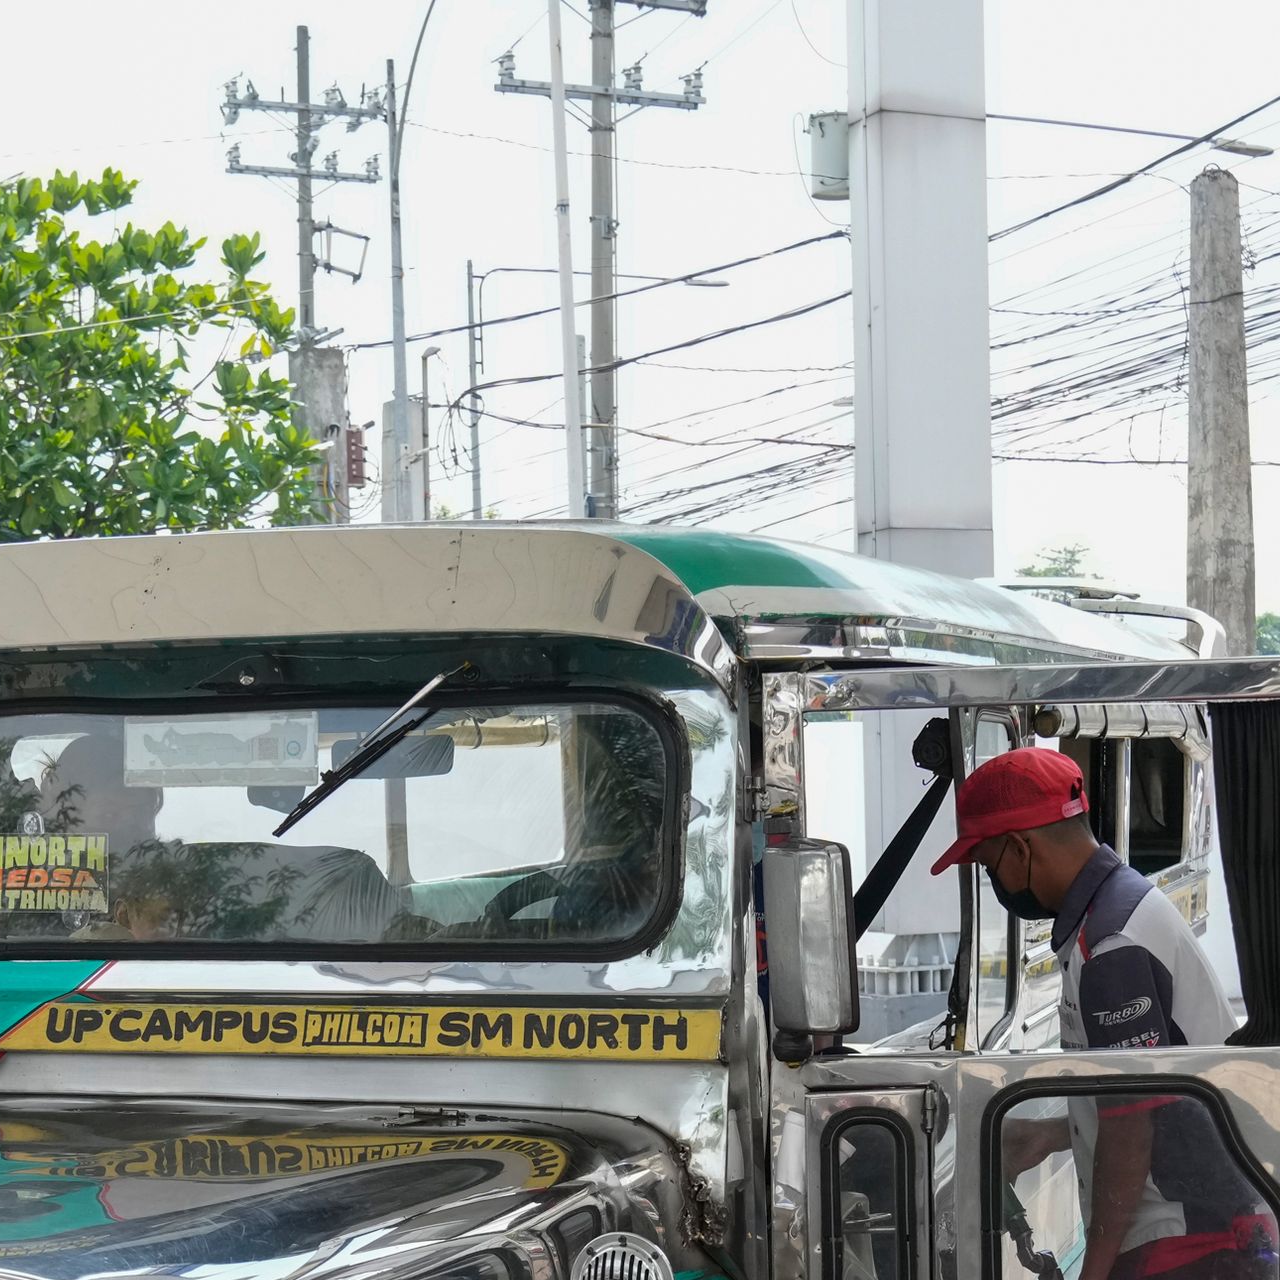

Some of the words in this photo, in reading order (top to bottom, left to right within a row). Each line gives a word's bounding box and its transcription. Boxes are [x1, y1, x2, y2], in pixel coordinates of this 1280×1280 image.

[5, 836, 106, 872] NORTH
[6, 868, 99, 888] EDSA
[5, 889, 109, 913] TRINOMA
[1092, 1003, 1140, 1025] TURBO
[109, 1009, 298, 1044] CAMPUS
[305, 1012, 425, 1045] PHILCOA
[437, 1011, 513, 1048] SM
[523, 1013, 688, 1050] NORTH
